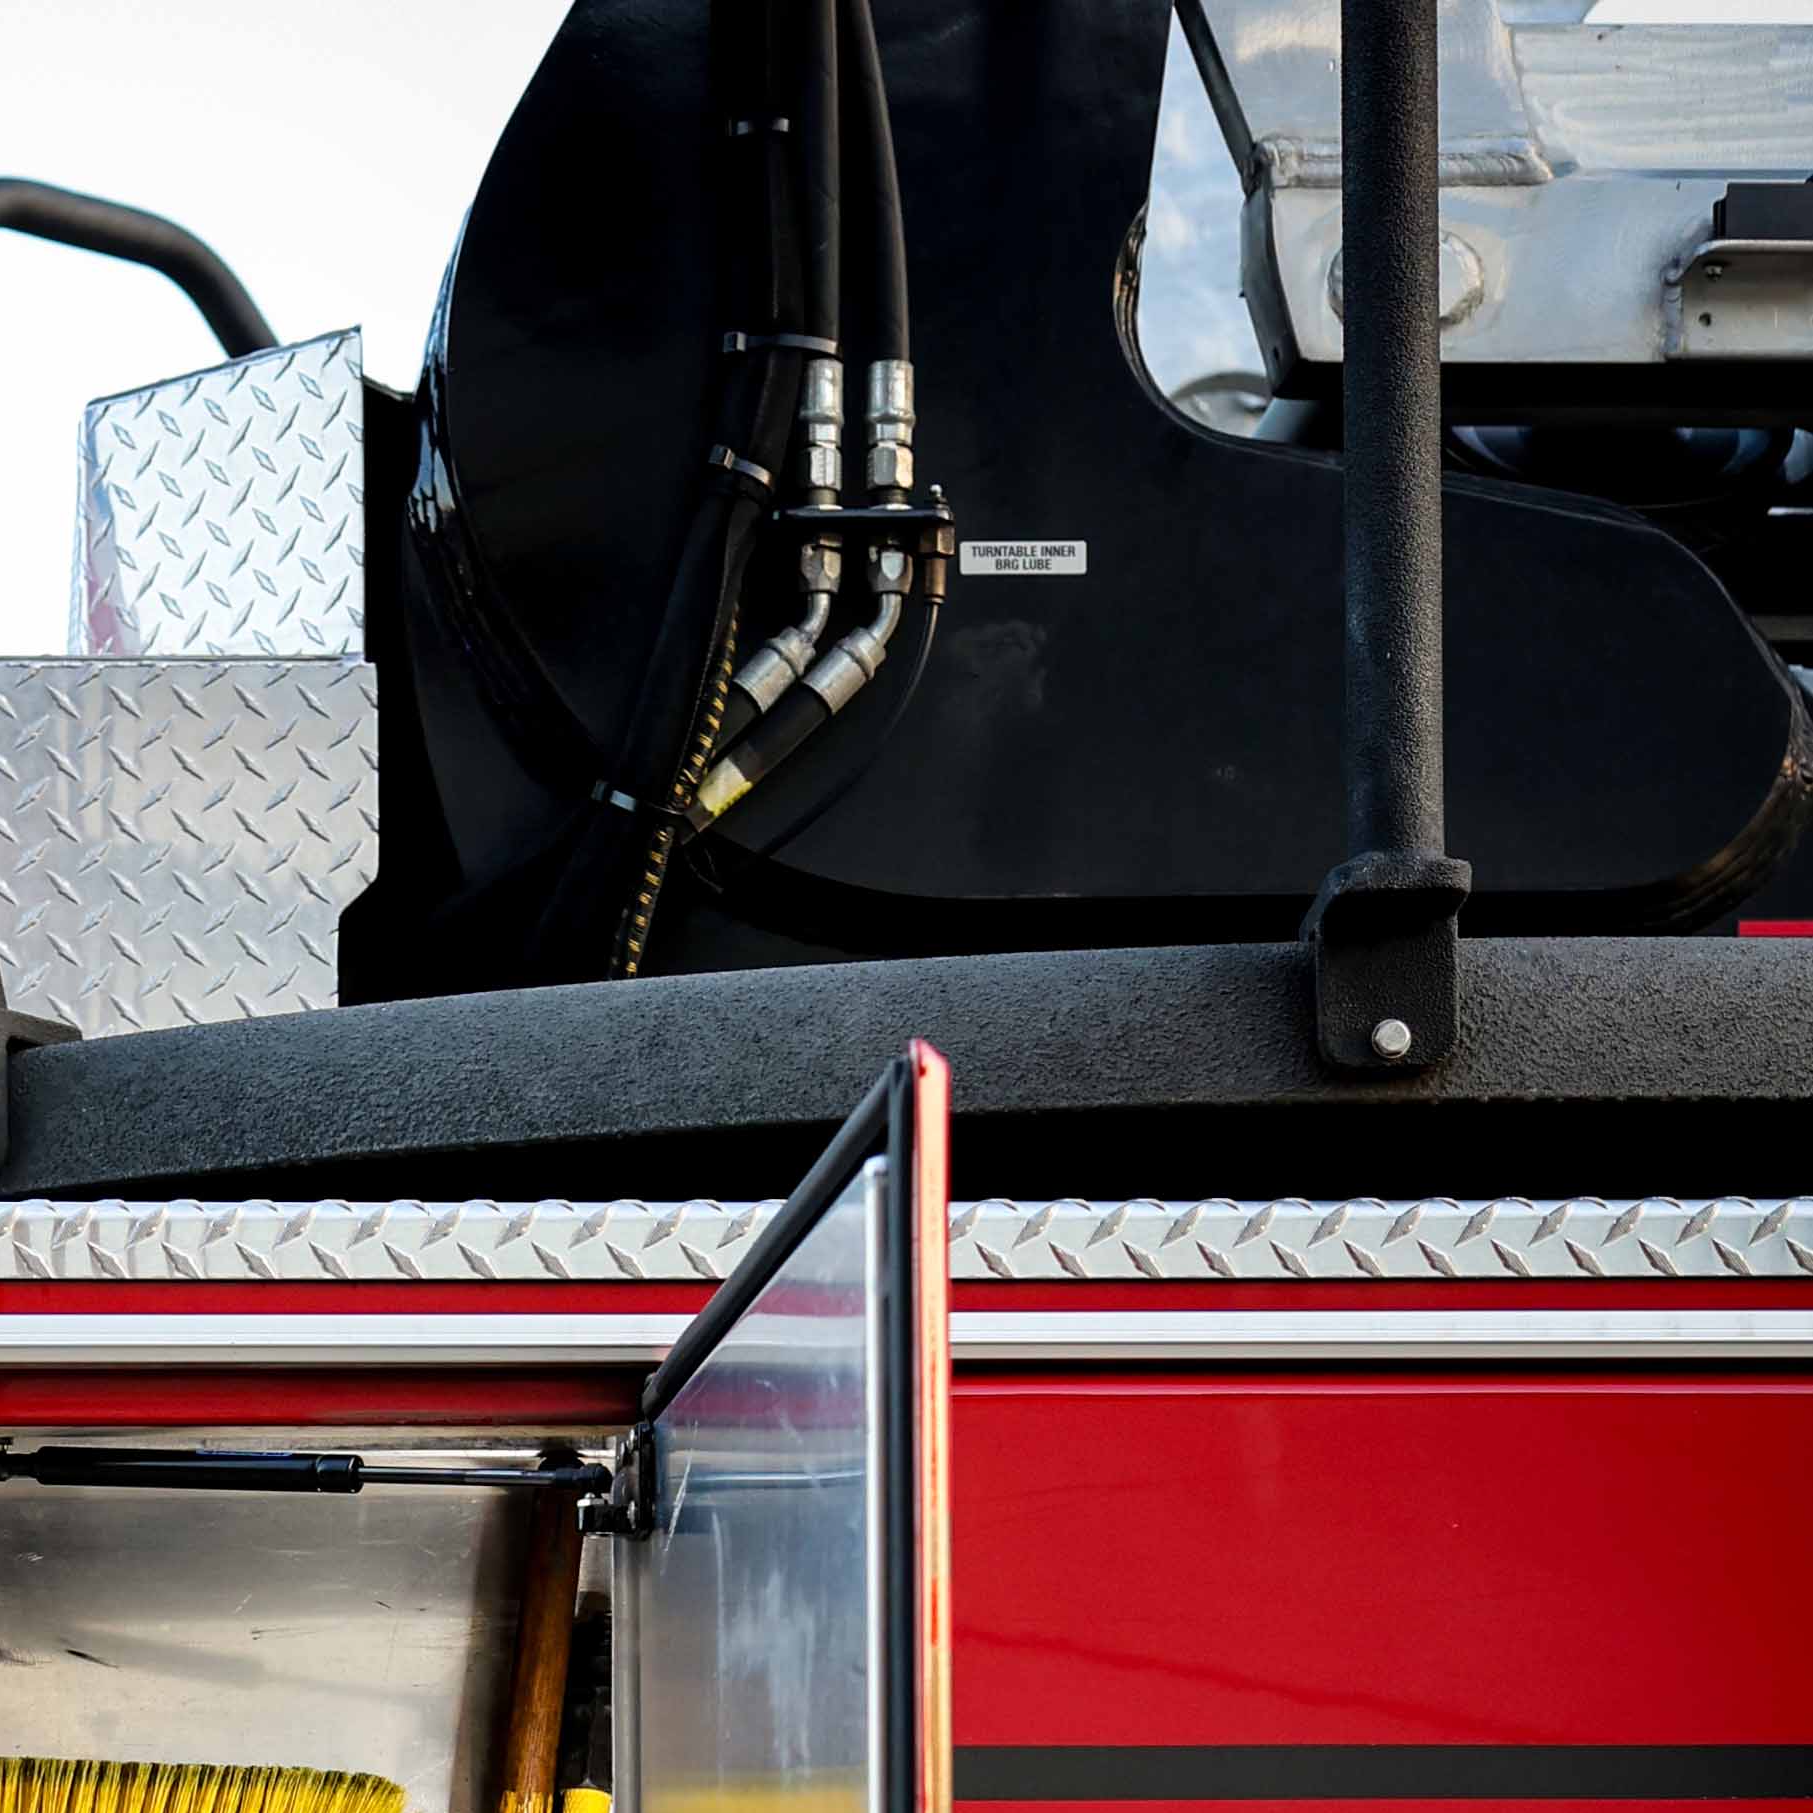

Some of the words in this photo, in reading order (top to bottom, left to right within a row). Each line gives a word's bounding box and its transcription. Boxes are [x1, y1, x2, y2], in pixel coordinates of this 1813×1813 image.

[971, 545, 1037, 557] TURNTABLE
[1040, 545, 1076, 557] INNER
[995, 558, 1020, 570] BRG
[1022, 558, 1052, 570] LUBE
